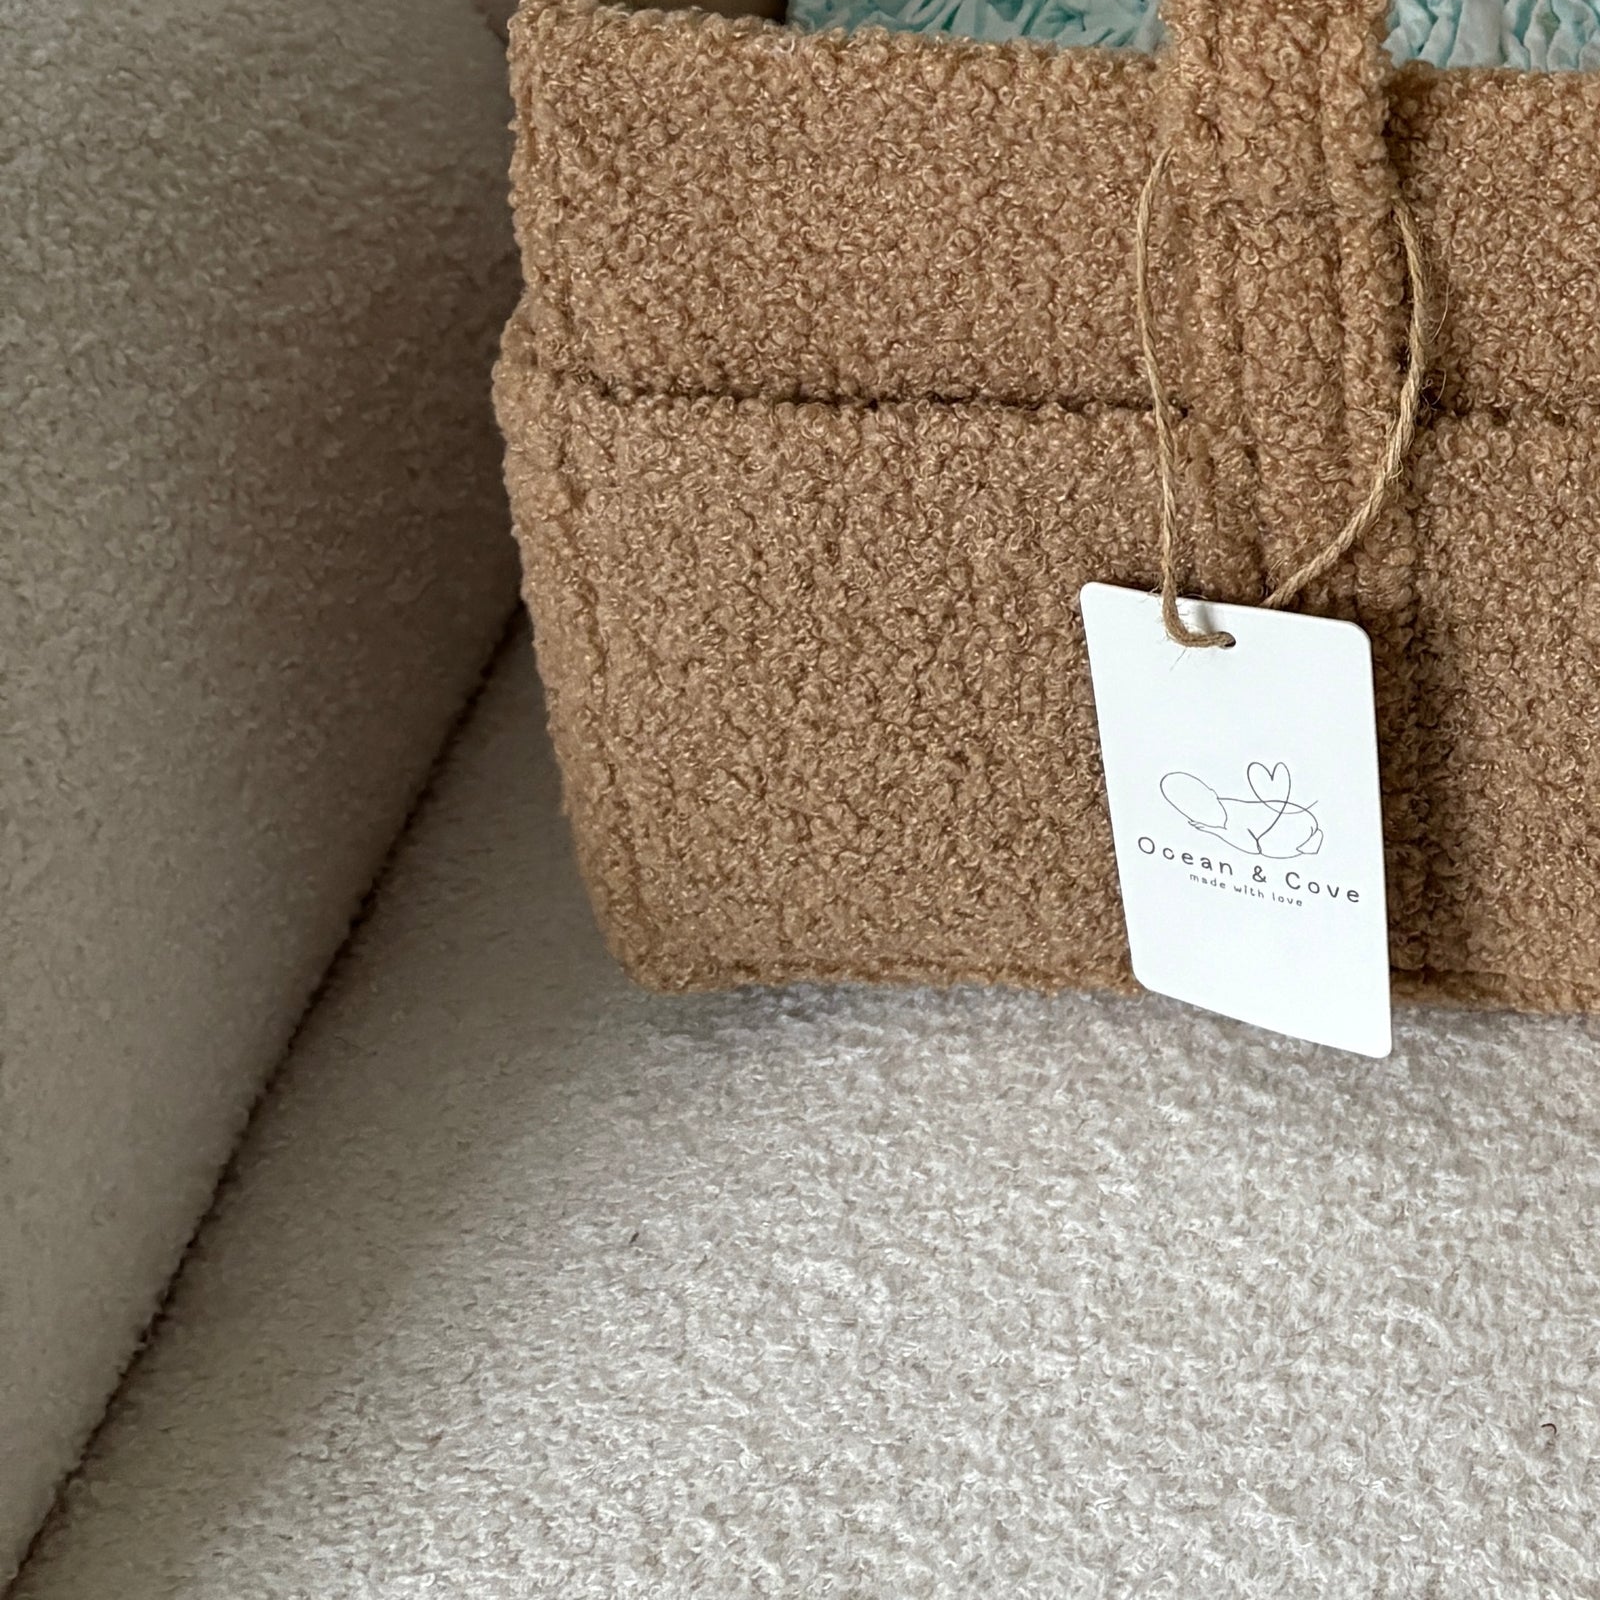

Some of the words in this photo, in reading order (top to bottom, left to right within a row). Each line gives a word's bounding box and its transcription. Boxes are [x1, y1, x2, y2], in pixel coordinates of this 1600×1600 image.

[1138, 836, 1233, 876] Ocean
[1253, 866, 1267, 883] &
[1286, 872, 1360, 903] Cove
[1189, 873, 1226, 889] made
[1233, 882, 1265, 900] with
[1272, 891, 1303, 907] love
